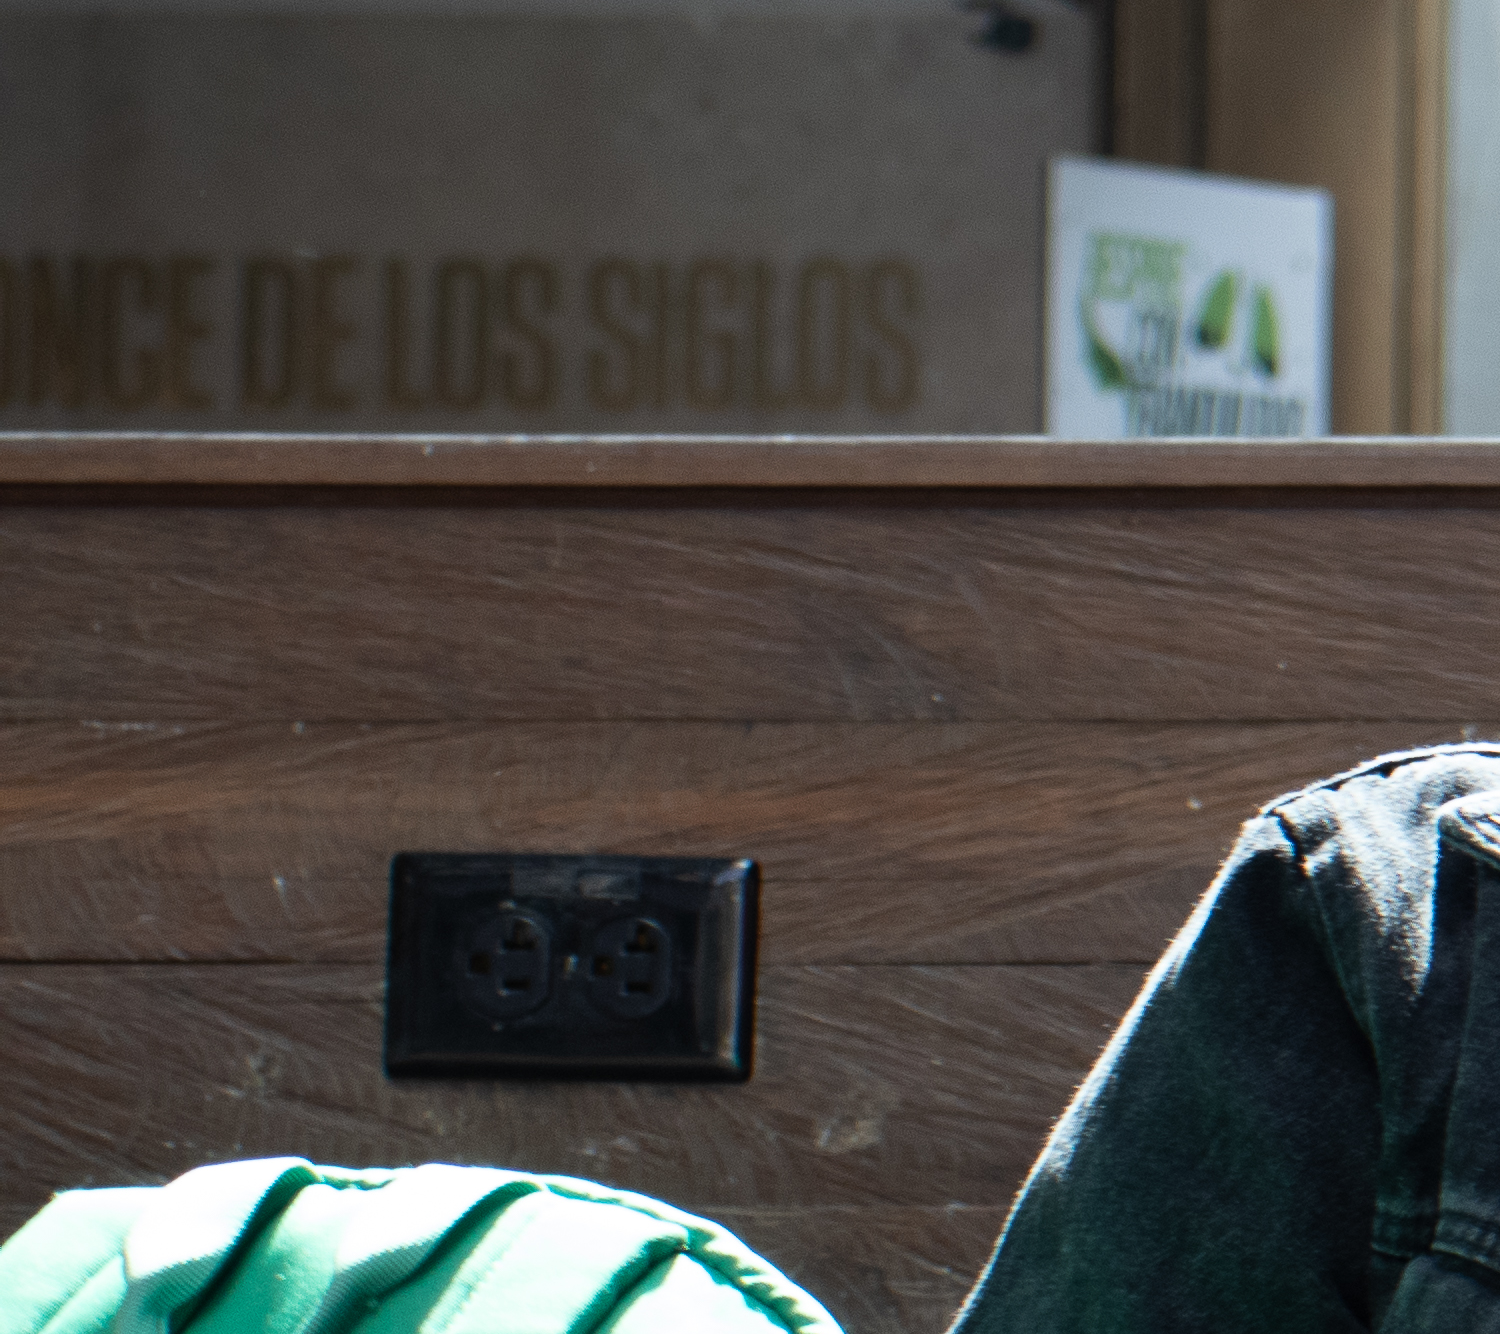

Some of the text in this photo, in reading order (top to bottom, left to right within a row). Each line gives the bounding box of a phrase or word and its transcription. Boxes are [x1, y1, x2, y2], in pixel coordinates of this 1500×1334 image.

[0, 253, 216, 415] NCE
[240, 254, 361, 415] DE
[385, 255, 561, 415] LOS
[587, 255, 924, 417] SIGLOS
